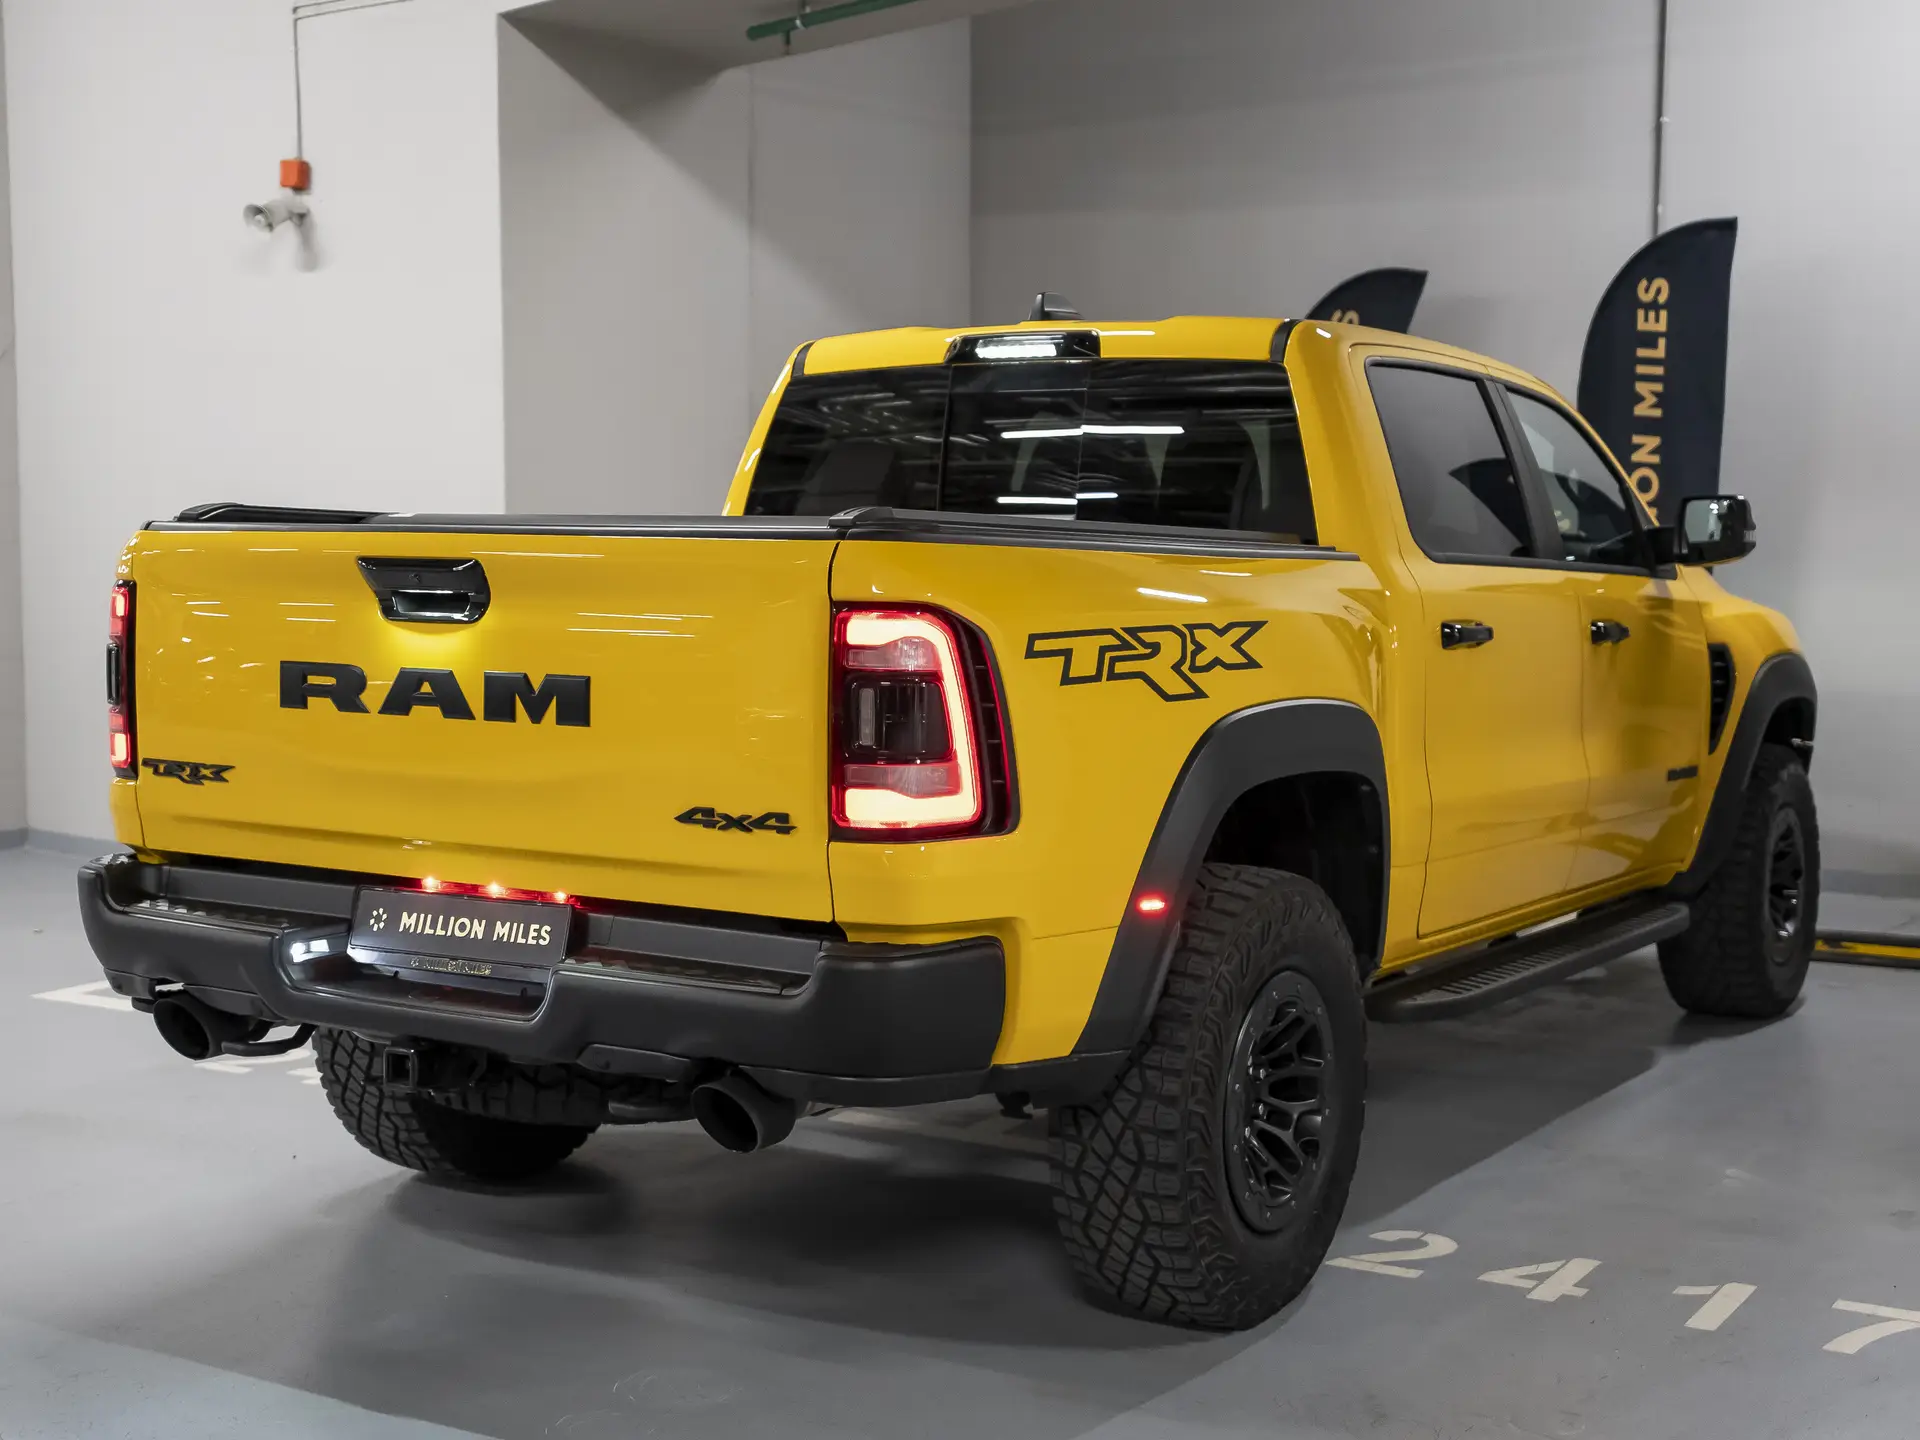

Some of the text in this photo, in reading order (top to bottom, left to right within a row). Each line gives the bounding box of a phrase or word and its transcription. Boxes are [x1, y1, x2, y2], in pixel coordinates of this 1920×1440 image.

[1633, 277, 1670, 418] MILES
[280, 660, 591, 727] RAM
[1024, 620, 1269, 702] TRX
[141, 757, 236, 785] TRX
[399, 911, 552, 946] MILLION MILES
